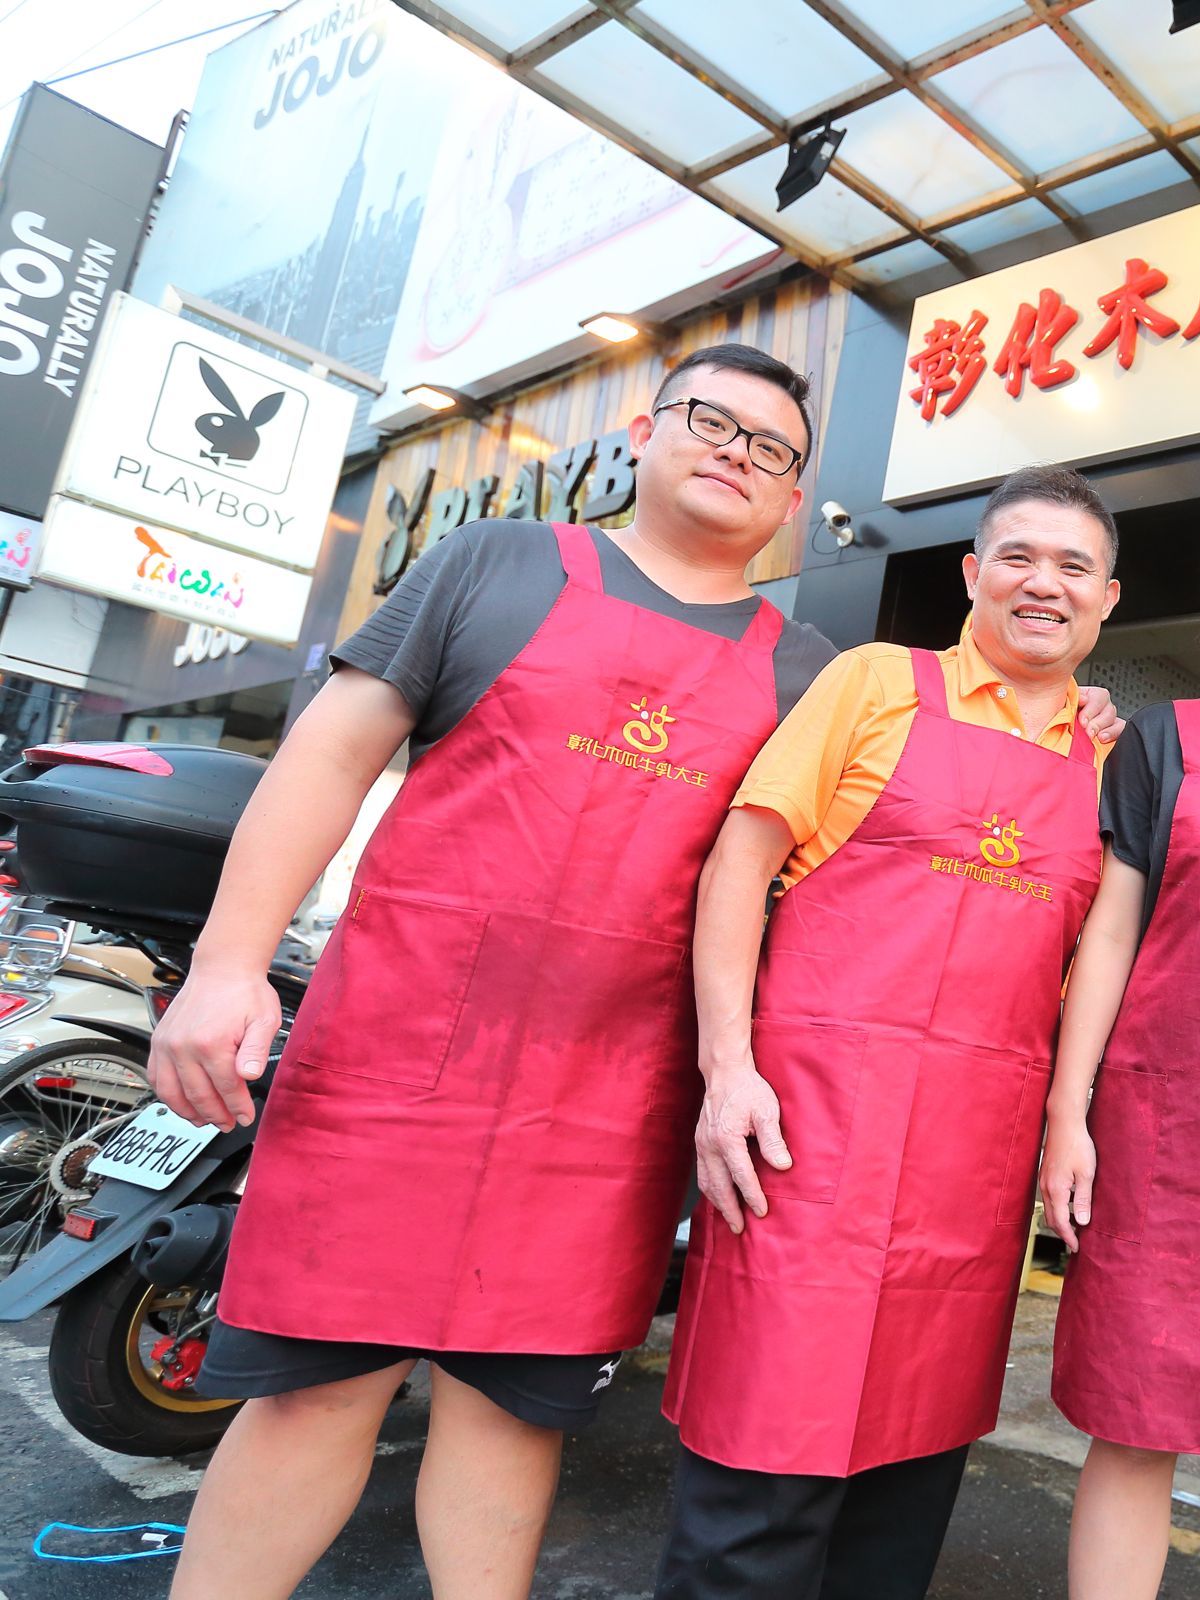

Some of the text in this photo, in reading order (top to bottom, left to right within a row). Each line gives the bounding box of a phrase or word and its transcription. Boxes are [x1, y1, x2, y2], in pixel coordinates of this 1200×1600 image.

[254, 20, 387, 130] JOJO
[0, 211, 73, 376] JOJO
[44, 238, 117, 398] NATURALLY
[113, 455, 295, 535] PLAYBOY
[566, 733, 710, 788] 彰化木瓜牛乳大王
[929, 855, 1054, 902] 彰化木瓜牛乳大王
